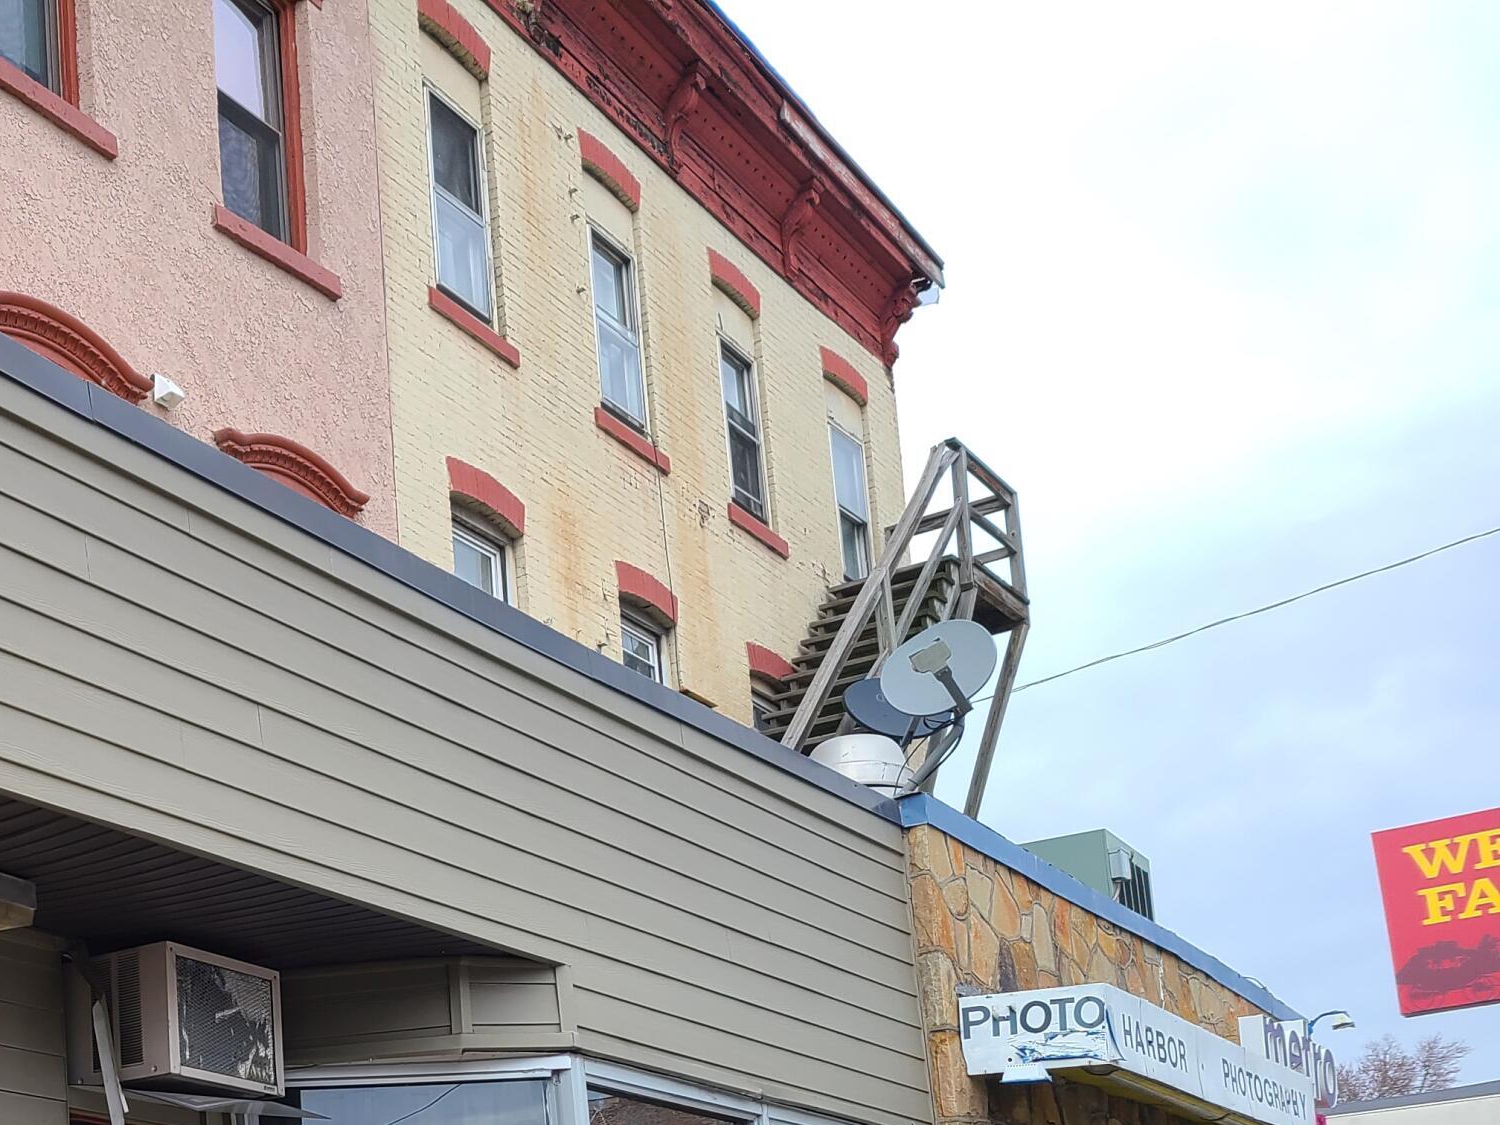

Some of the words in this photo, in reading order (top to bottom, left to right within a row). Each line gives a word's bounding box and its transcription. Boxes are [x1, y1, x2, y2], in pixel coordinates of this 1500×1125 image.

[961, 996, 1106, 1040] PHOTO
[1121, 1013, 1189, 1073] HARBOR
[1221, 1057, 1306, 1121] PHOTOGRAPHY
